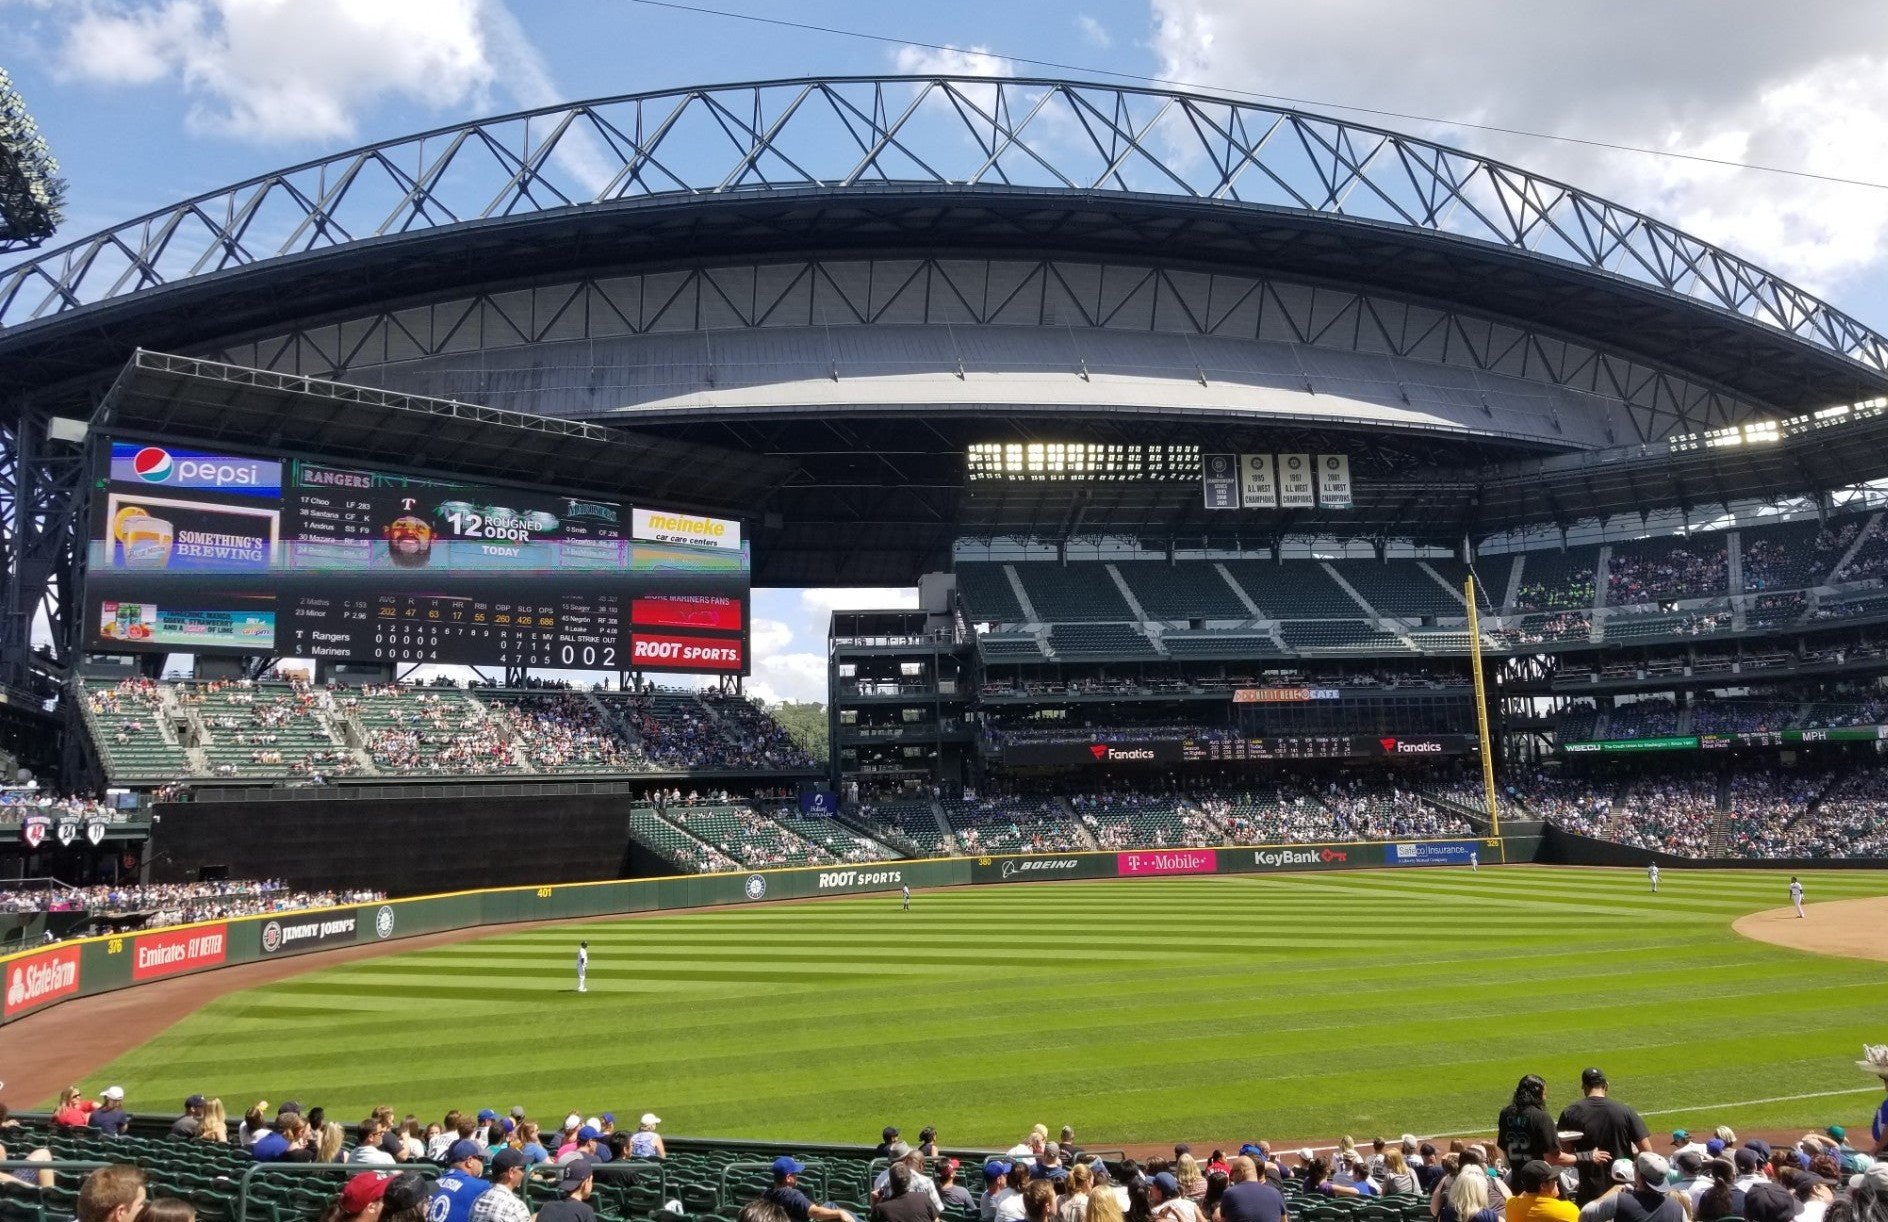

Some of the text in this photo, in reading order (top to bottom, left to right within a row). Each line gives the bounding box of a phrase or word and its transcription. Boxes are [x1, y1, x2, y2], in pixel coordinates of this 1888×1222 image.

[178, 460, 258, 485] pepsi
[304, 470, 370, 488] RANGERS
[310, 497, 329, 505] Choo
[310, 510, 339, 519] Santana
[309, 522, 334, 531] Andrus
[448, 512, 482, 537] 12
[484, 516, 542, 531] ROUGNED
[649, 514, 725, 537] meineke
[178, 530, 262, 550] SOMETHING'S
[484, 526, 530, 542] ODOR
[656, 533, 668, 541] car
[690, 537, 718, 547] centers
[176, 544, 262, 561] BREWING
[482, 545, 520, 557] TODAY
[405, 608, 416, 617] 47
[428, 610, 440, 618] 63
[453, 612, 462, 620] 17
[474, 613, 485, 622] 55
[312, 631, 350, 642] Rangers
[376, 634, 383, 643] 0
[389, 634, 396, 644] 0
[403, 636, 410, 644] 0
[417, 636, 424, 645] 0
[430, 637, 437, 646] 0
[500, 641, 507, 649] 0
[516, 642, 522, 650] 7
[532, 642, 536, 651] 1
[544, 643, 550, 651] 4
[312, 646, 351, 656] Mariners
[375, 648, 382, 658] 0
[389, 649, 396, 658] 0
[402, 650, 409, 658] 0
[416, 650, 423, 659] 0
[430, 651, 437, 659] 4
[516, 655, 522, 663] 7
[544, 656, 550, 664] 5
[562, 646, 616, 666] 0 0 2
[634, 641, 736, 660] ROOT SPORTS
[1802, 732, 1826, 742] MPH
[1108, 748, 1154, 759] Fanatics
[1398, 742, 1442, 752] Fanatics
[1254, 850, 1320, 866] KeyBank
[1399, 845, 1465, 855] Safeco Insurance
[1020, 860, 1078, 870] BOEING
[819, 871, 901, 888] ROOT SPORTS
[537, 888, 552, 898] 401
[282, 923, 319, 944] JIMMY
[320, 918, 356, 938] JOHN'S
[108, 938, 123, 954] 376
[139, 934, 223, 968] Emirates FLY BETTER
